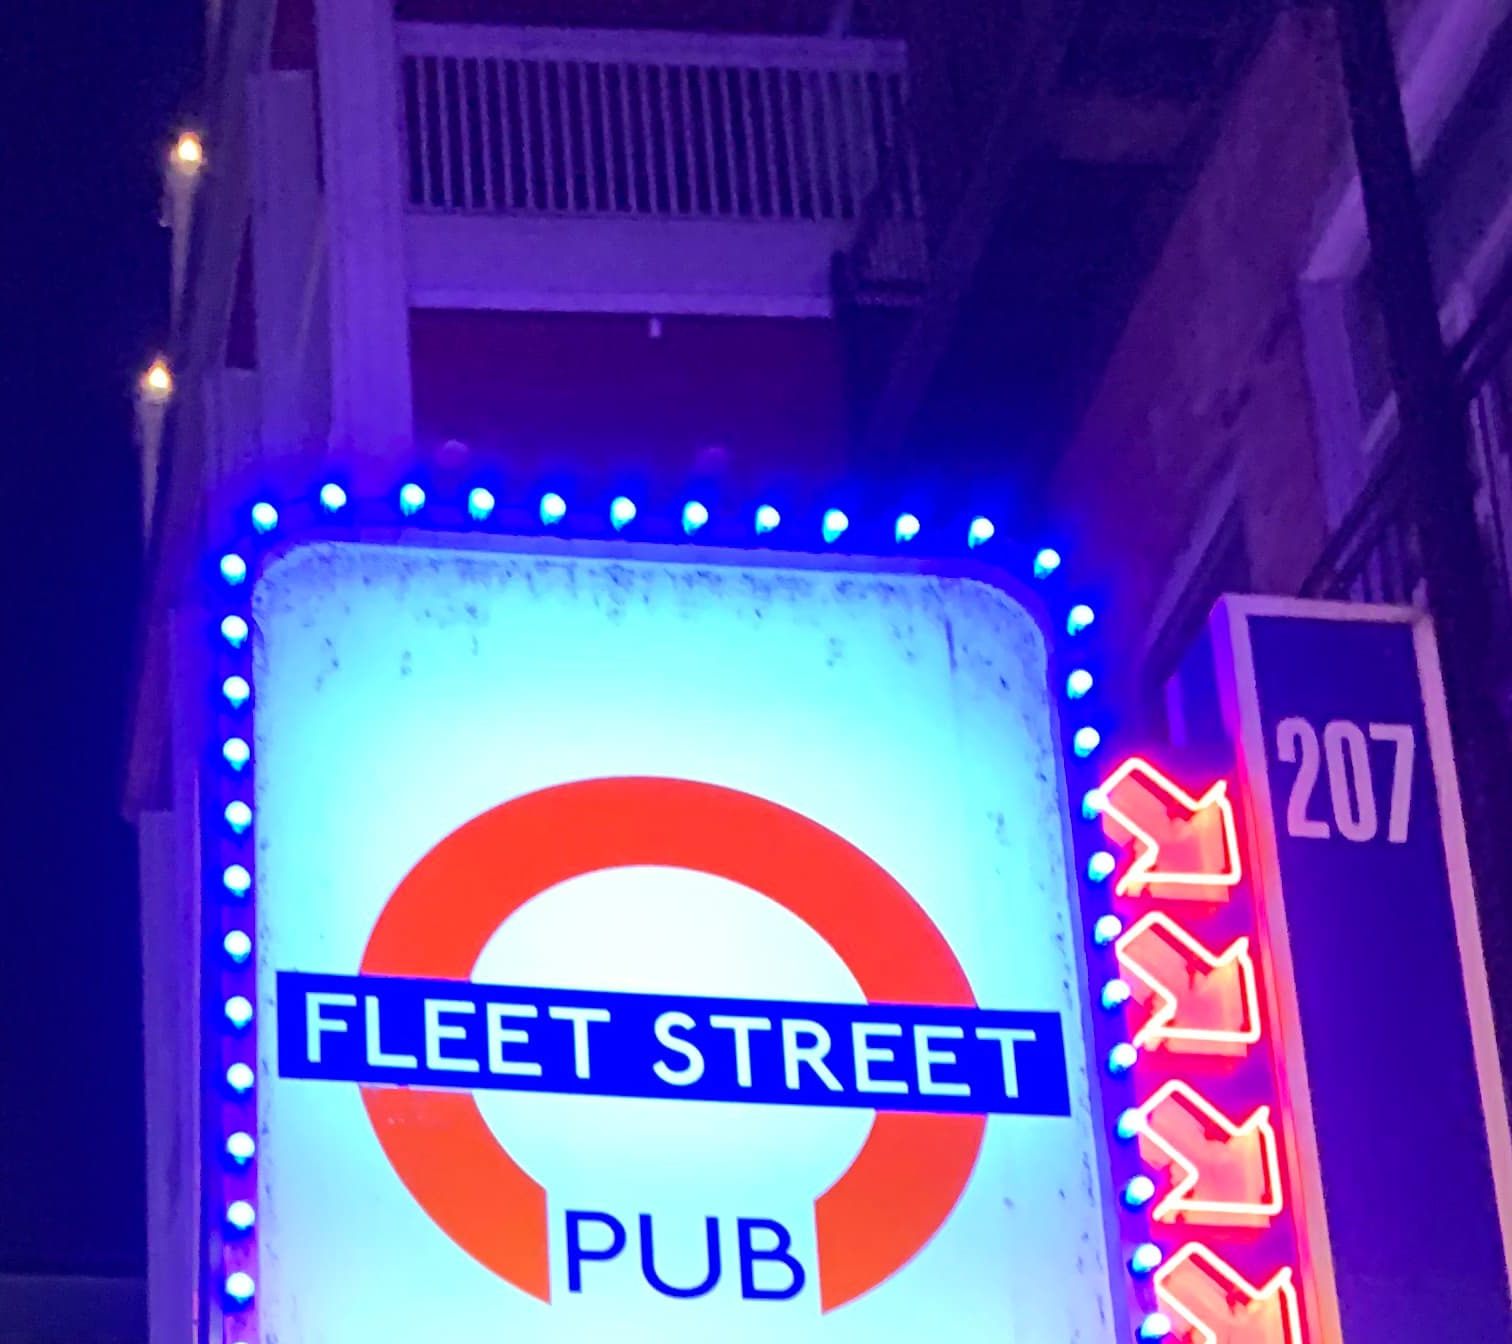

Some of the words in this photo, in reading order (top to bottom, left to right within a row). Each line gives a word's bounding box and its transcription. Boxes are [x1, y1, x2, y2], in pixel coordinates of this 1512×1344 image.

[1276, 716, 1414, 843] 207
[305, 991, 611, 1079] FLEET
[652, 1010, 1037, 1098] STREET
[565, 1210, 806, 1301] PUB
